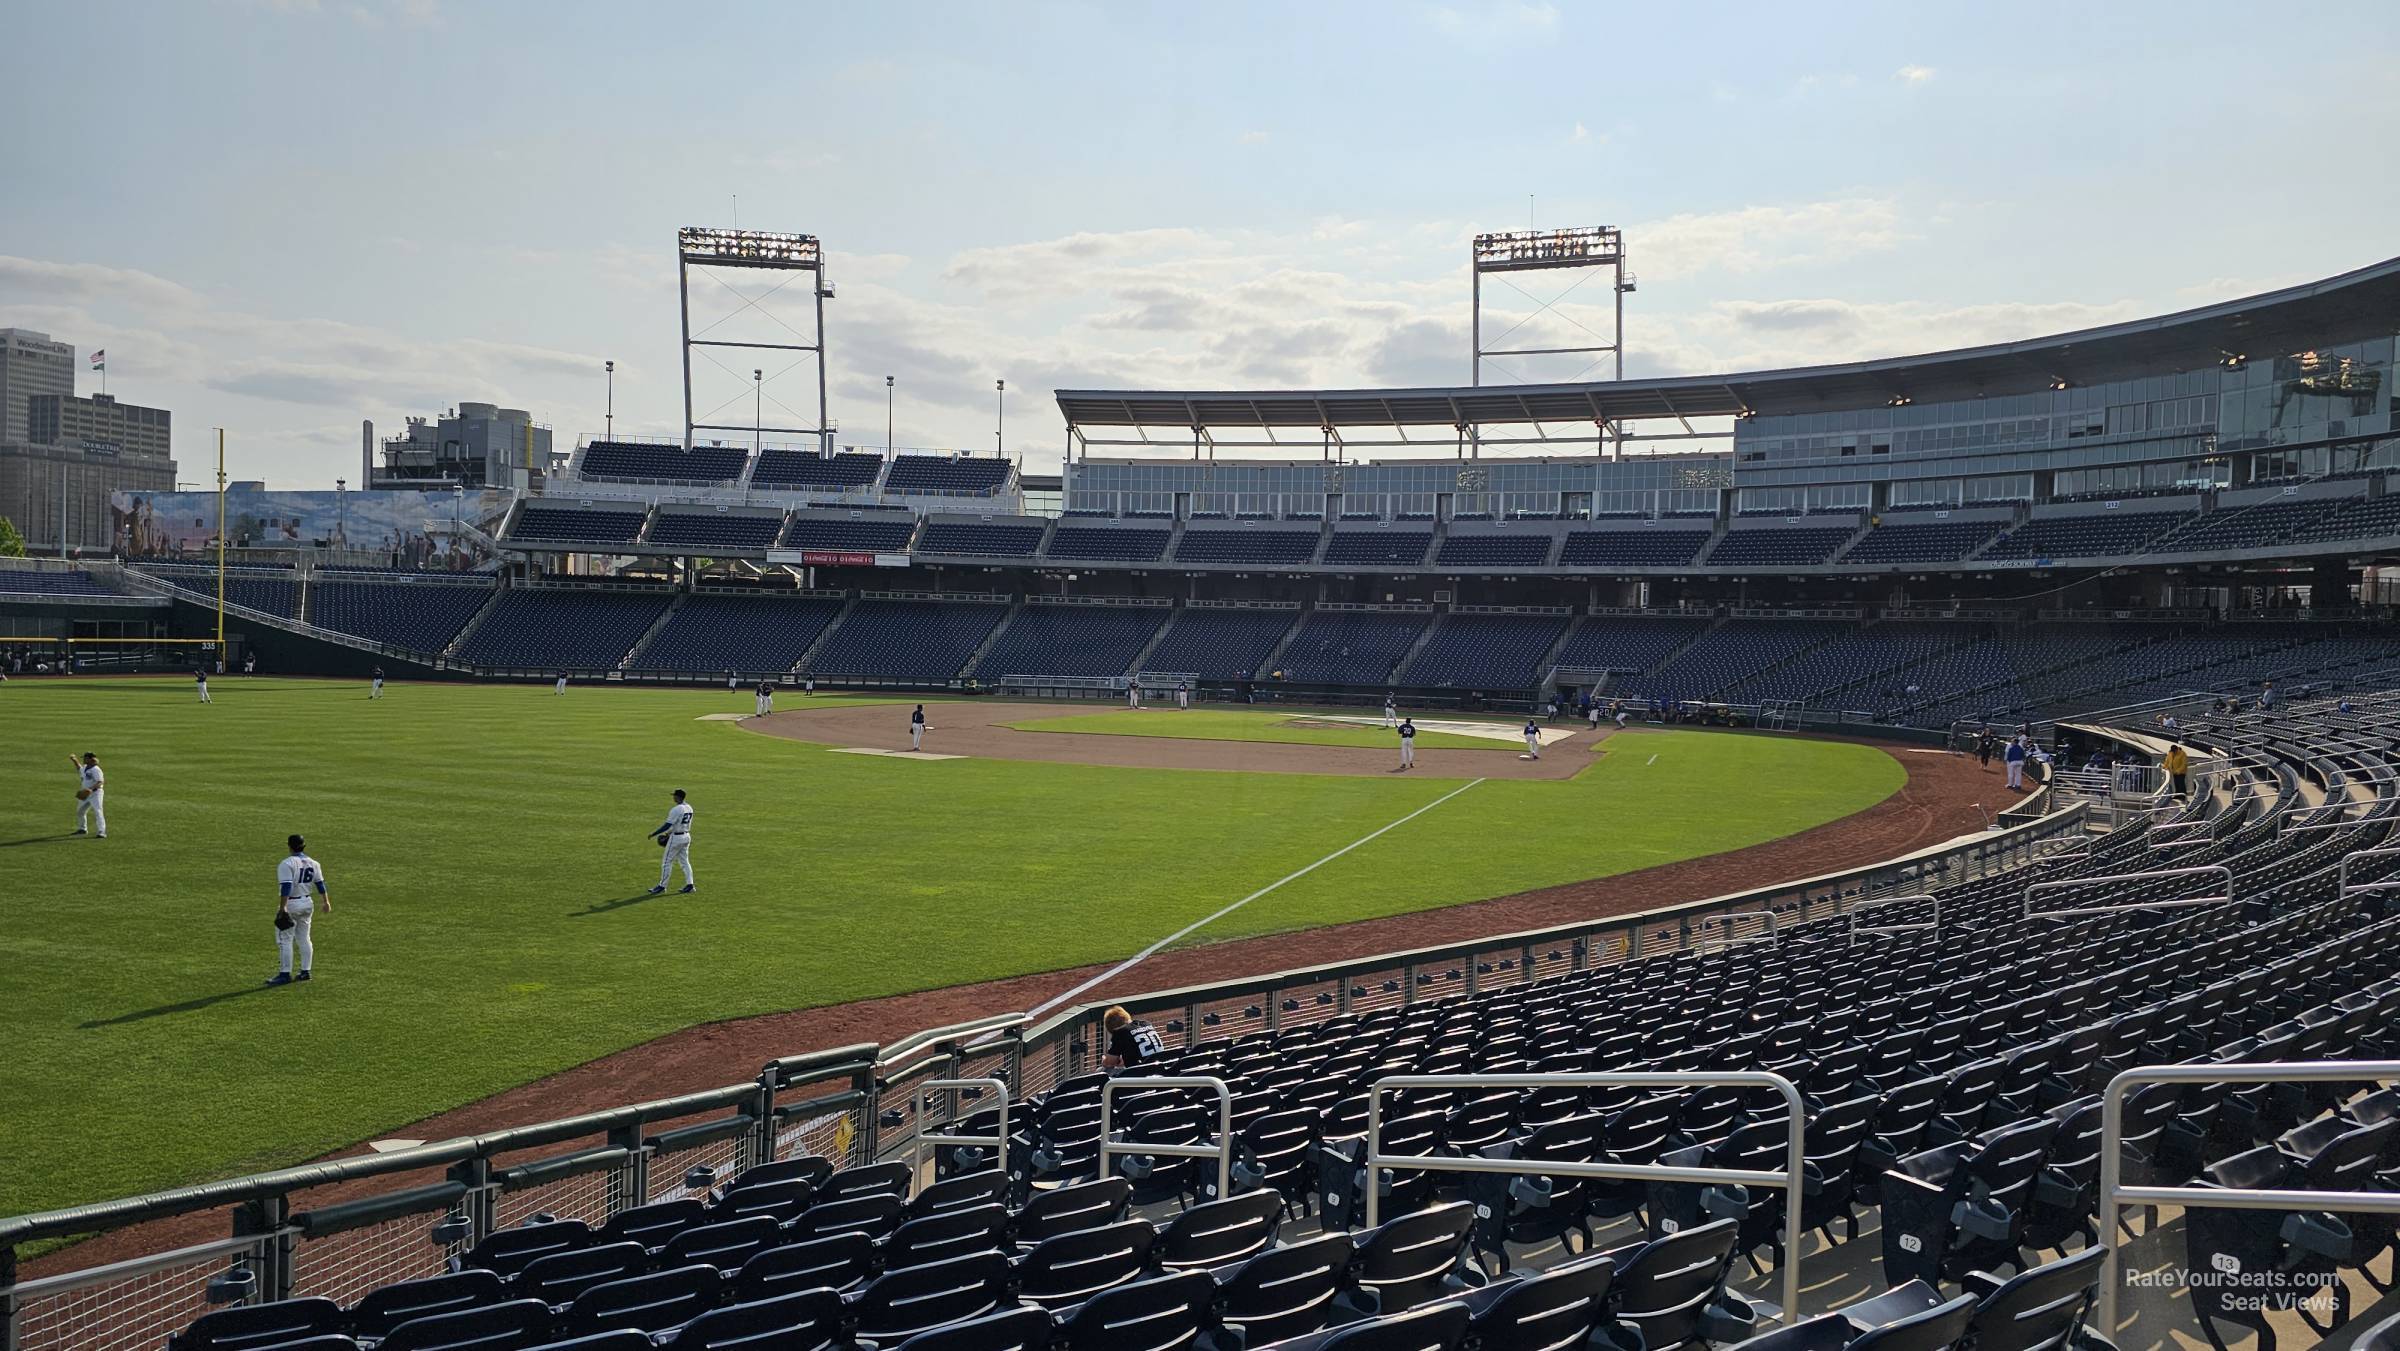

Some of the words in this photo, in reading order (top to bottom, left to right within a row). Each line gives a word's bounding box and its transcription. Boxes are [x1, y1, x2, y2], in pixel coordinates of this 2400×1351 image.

[17, 338, 68, 354] WoodmenLife
[202, 642, 216, 650] 335
[682, 812, 693, 825] 27
[298, 867, 315, 884] 16
[1133, 1030, 1165, 1058] 20
[1480, 1207, 1489, 1217] 10
[1666, 1221, 1676, 1232] 11
[1904, 1237, 1917, 1249] 12
[2217, 1256, 2234, 1270] 13
